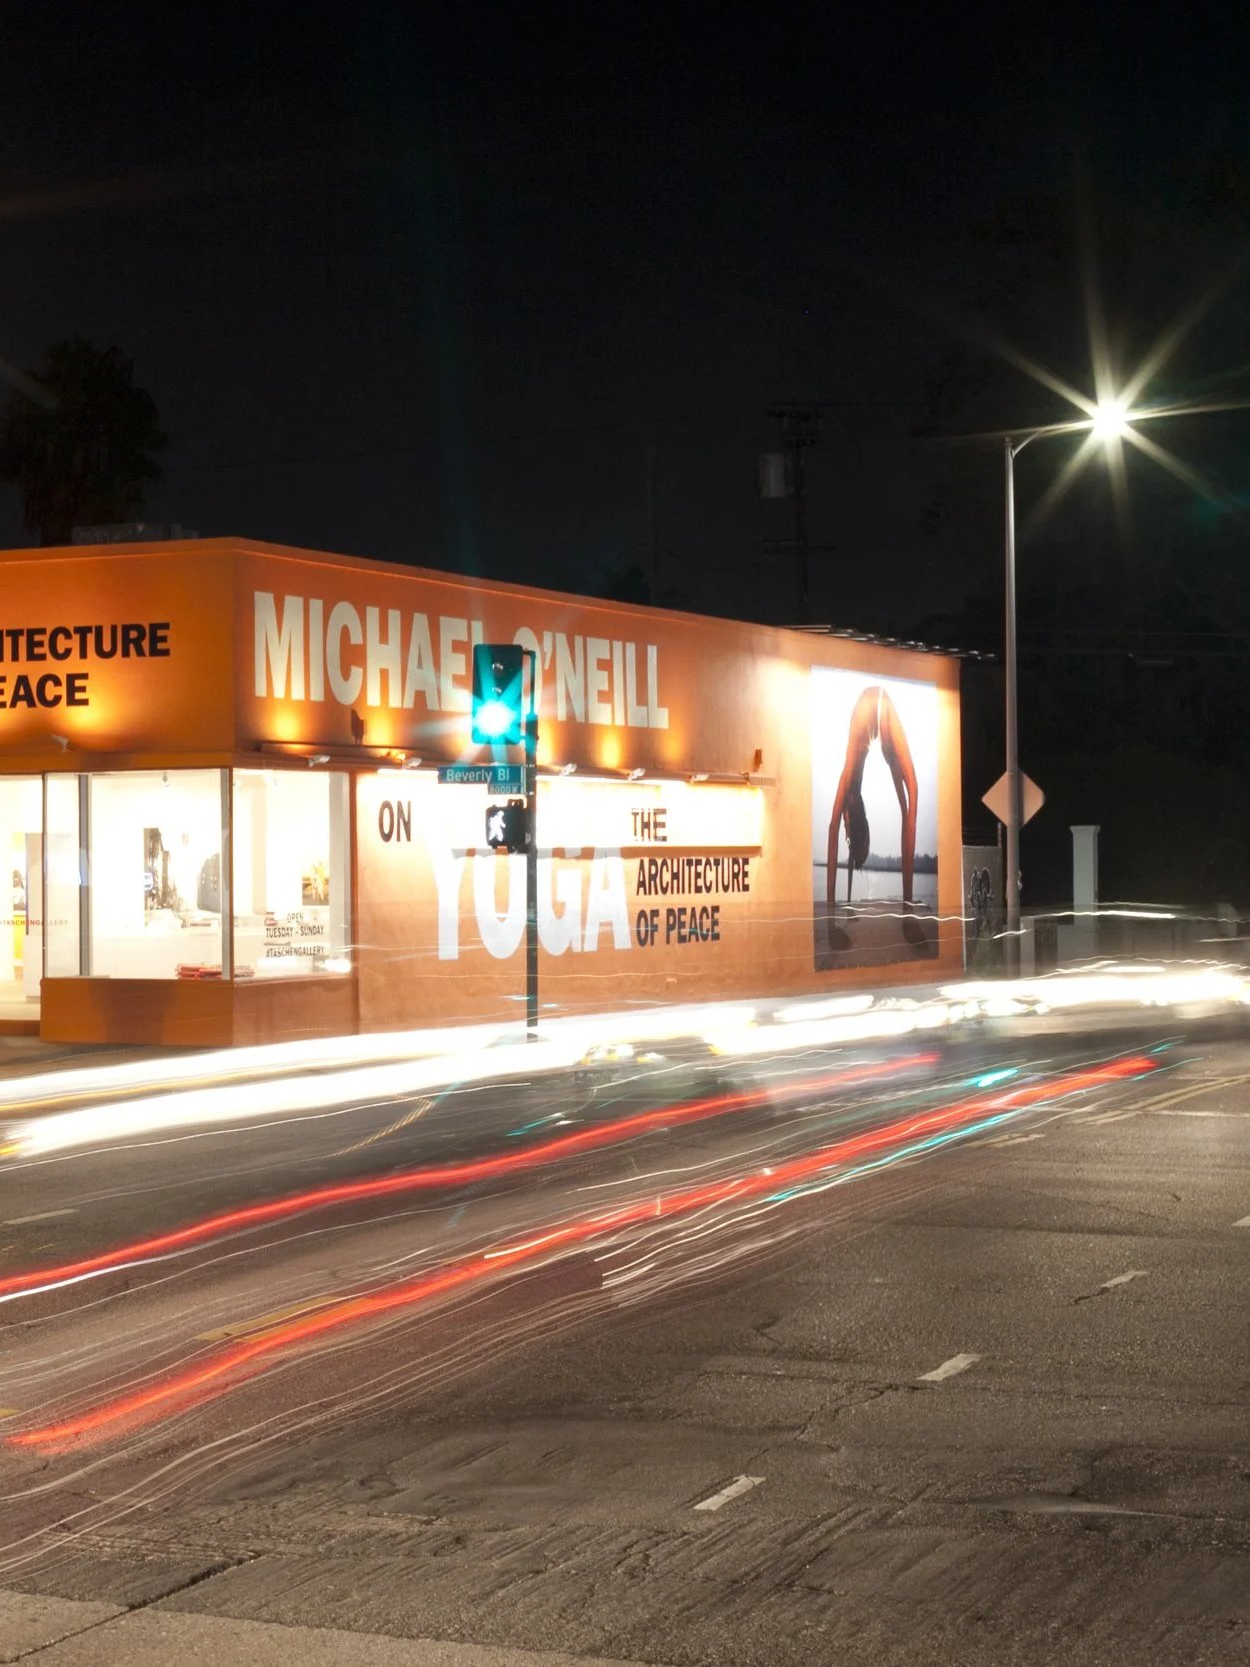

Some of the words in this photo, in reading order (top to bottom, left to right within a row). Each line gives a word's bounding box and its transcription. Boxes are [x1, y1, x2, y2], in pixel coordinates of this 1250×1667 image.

[254, 591, 483, 711] MICHAE
[512, 626, 669, 729] O'NEILL
[446, 769, 492, 784] Beverly
[498, 768, 510, 781] Bl
[631, 808, 667, 842] THE
[378, 800, 411, 843] ON
[431, 847, 632, 960] YOGA
[636, 856, 750, 896] ARCHITECTURE
[266, 927, 294, 938] TUESDAY
[300, 925, 324, 936] SUNDAY
[287, 912, 304, 924] OPEN
[636, 908, 660, 947] OF
[665, 905, 720, 945] PEACE
[266, 945, 324, 958] #TASCHENGALLERY
